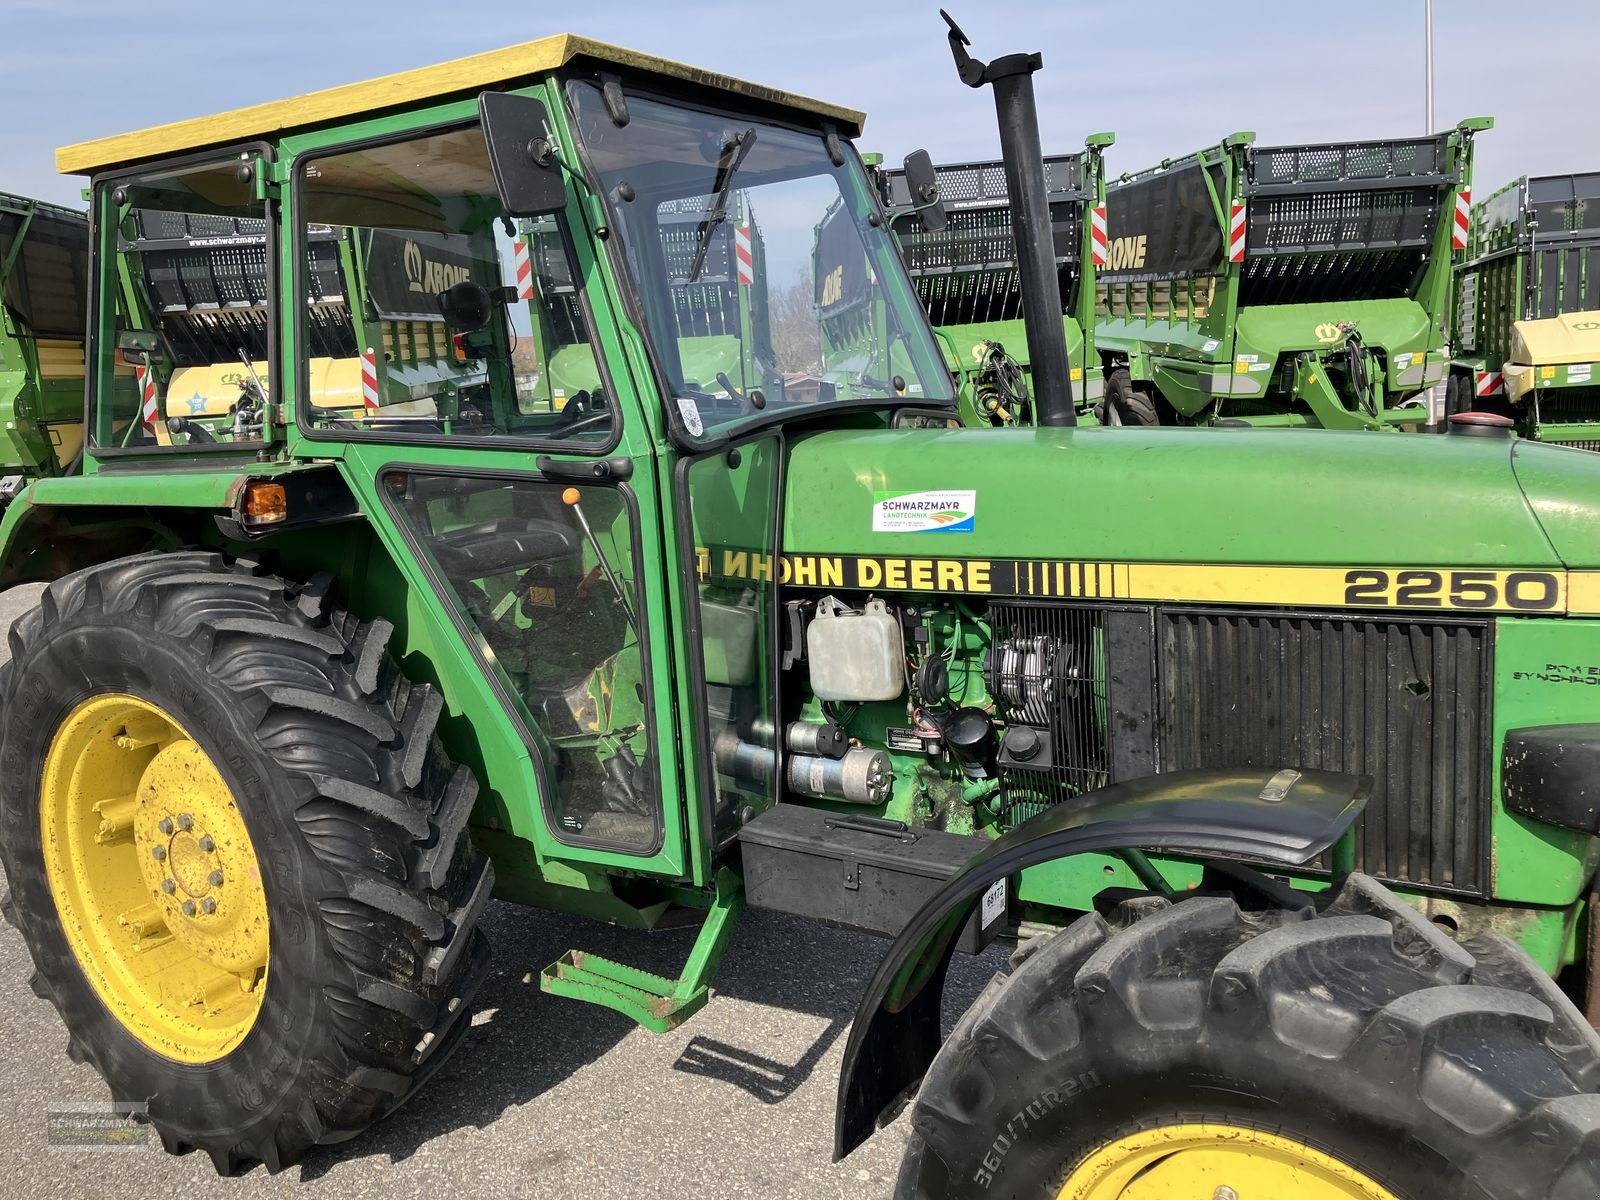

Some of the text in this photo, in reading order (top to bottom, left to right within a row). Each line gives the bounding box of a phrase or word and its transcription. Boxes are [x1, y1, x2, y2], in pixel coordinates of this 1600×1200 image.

[954, 199, 1009, 208] www.schwarzmayr.a
[1096, 235, 1147, 271] RONE
[882, 501, 960, 511] SCHWARZMAYR
[778, 557, 992, 592] OHN DEERE
[1344, 570, 1559, 610] 2250
[1545, 663, 1600, 676] POWE
[1513, 671, 1600, 685] SYNCHRO
